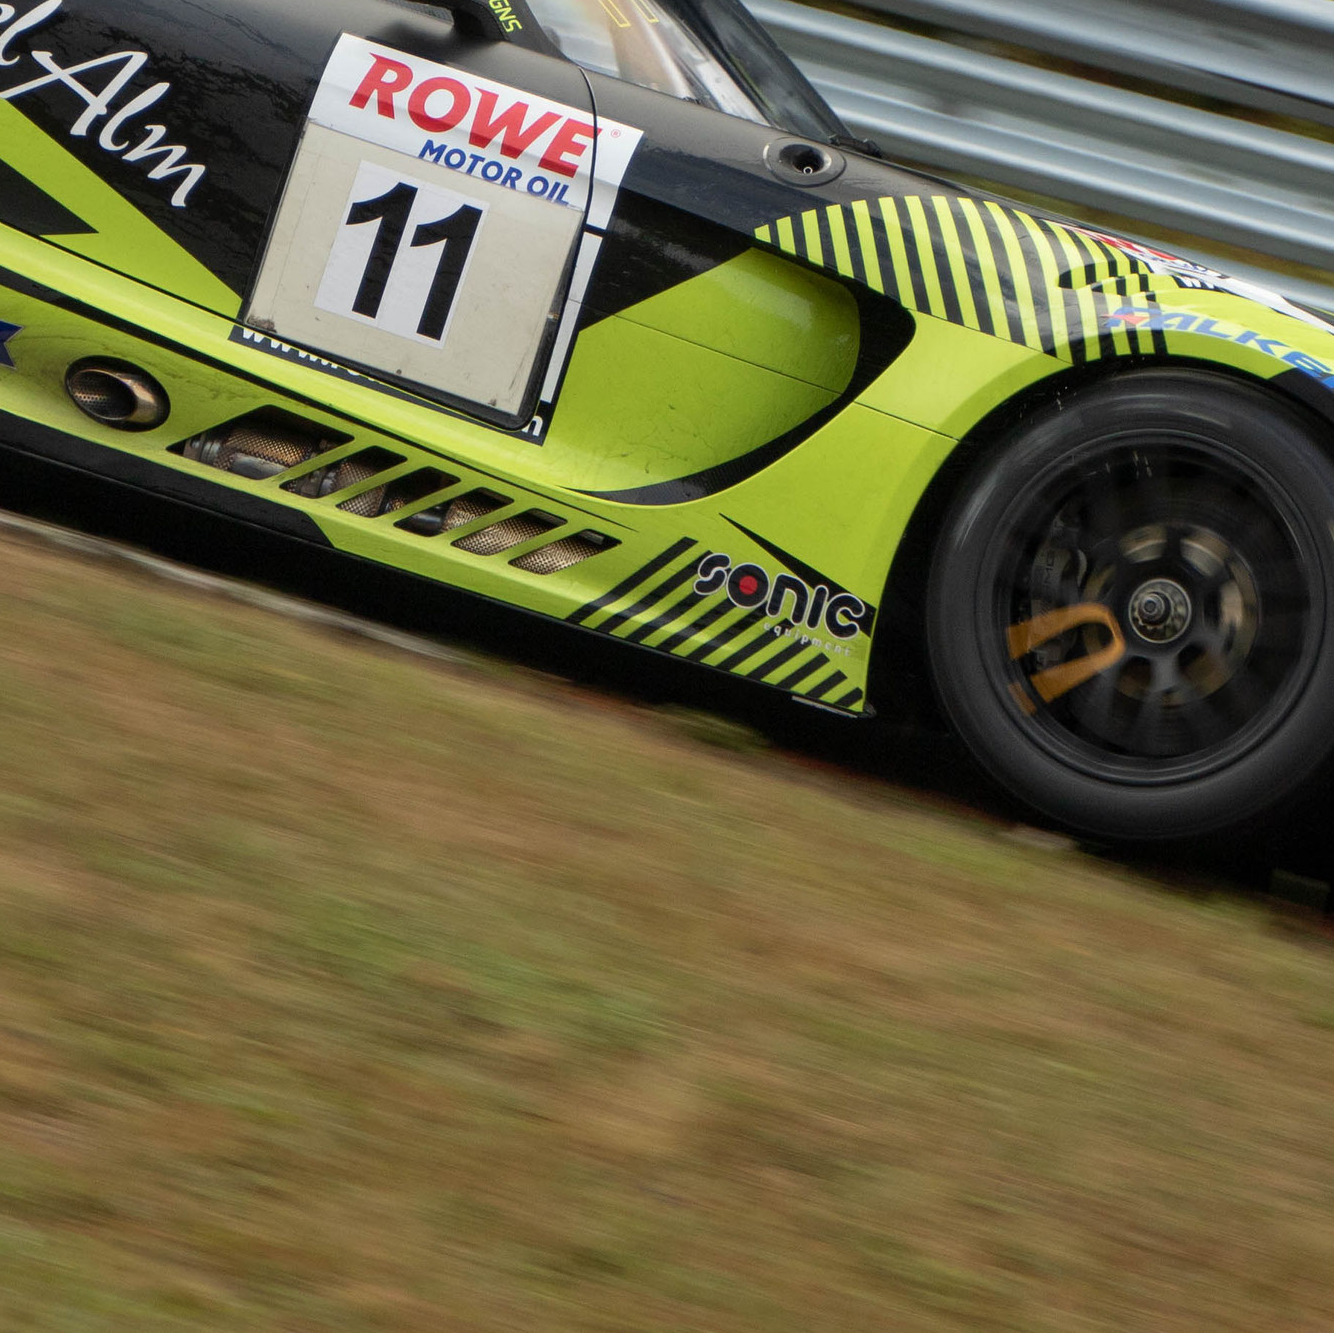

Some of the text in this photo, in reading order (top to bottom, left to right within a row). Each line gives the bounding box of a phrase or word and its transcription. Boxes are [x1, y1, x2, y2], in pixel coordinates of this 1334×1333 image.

[348, 52, 603, 179] ROWE
[418, 139, 570, 207] MOTOR OIL
[345, 181, 484, 342] 11
[763, 622, 851, 657] equipment
